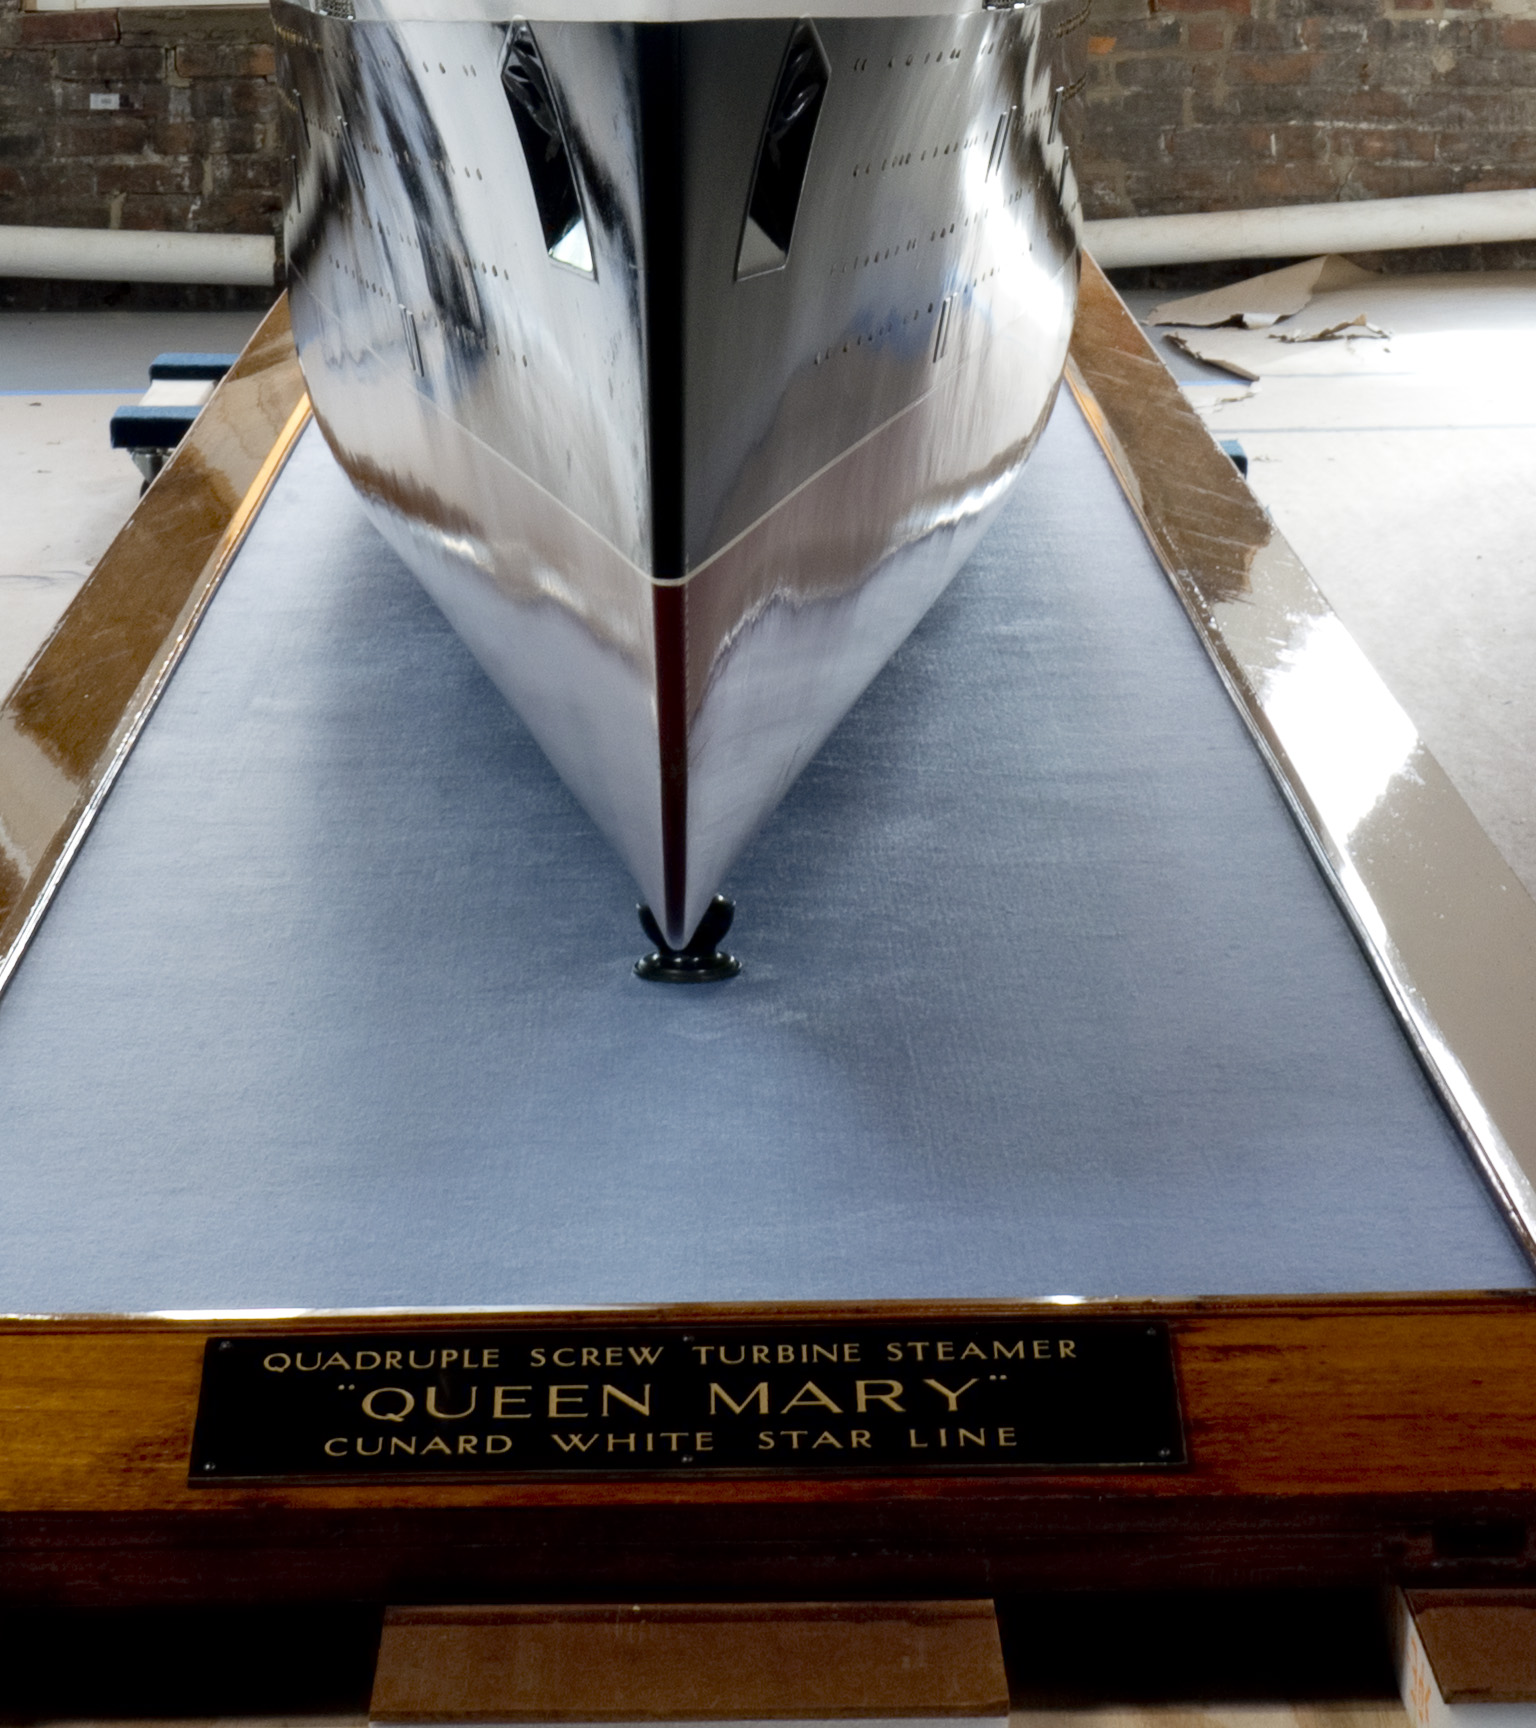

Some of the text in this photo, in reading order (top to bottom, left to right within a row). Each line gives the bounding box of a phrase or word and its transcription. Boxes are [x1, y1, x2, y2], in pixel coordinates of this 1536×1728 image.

[263, 1340, 1076, 1373] QUADRUPLE SCREW TURBINE STEAMER
[324, 1427, 1017, 1456] CUNARD WHITE STAR LINE
